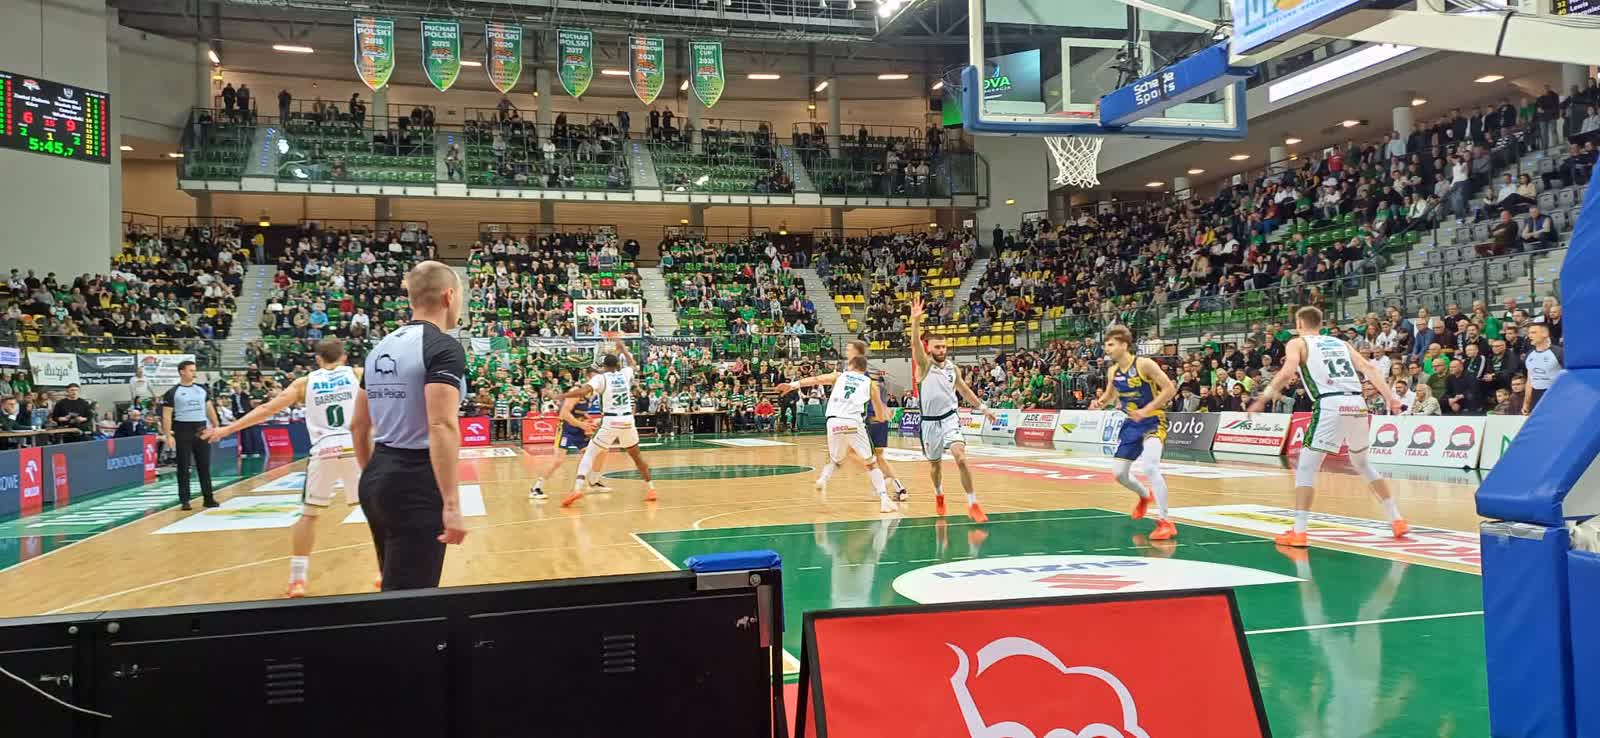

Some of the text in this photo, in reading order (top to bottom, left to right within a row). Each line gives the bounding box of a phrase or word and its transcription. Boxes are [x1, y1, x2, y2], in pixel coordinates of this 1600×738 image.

[1570, 2, 1588, 11] Lewis
[357, 28, 391, 36] POLSKI
[560, 39, 589, 47] POLSKI
[22, 111, 33, 124] 6
[65, 119, 77, 132] 9
[20, 127, 28, 136] 2
[47, 132, 54, 141] 1
[73, 136, 81, 145] 2
[596, 306, 634, 314] SUZUKI
[1323, 359, 1355, 378] 13
[844, 386, 856, 399] 7
[314, 391, 352, 406] GARRISON
[612, 393, 628, 406] 32
[325, 404, 345, 428] 0
[1369, 447, 1393, 455] ITAKA
[1404, 449, 1429, 457] ITAKA
[1441, 450, 1468, 459] ITAKA
[931, 560, 1149, 578] SUZUKI
